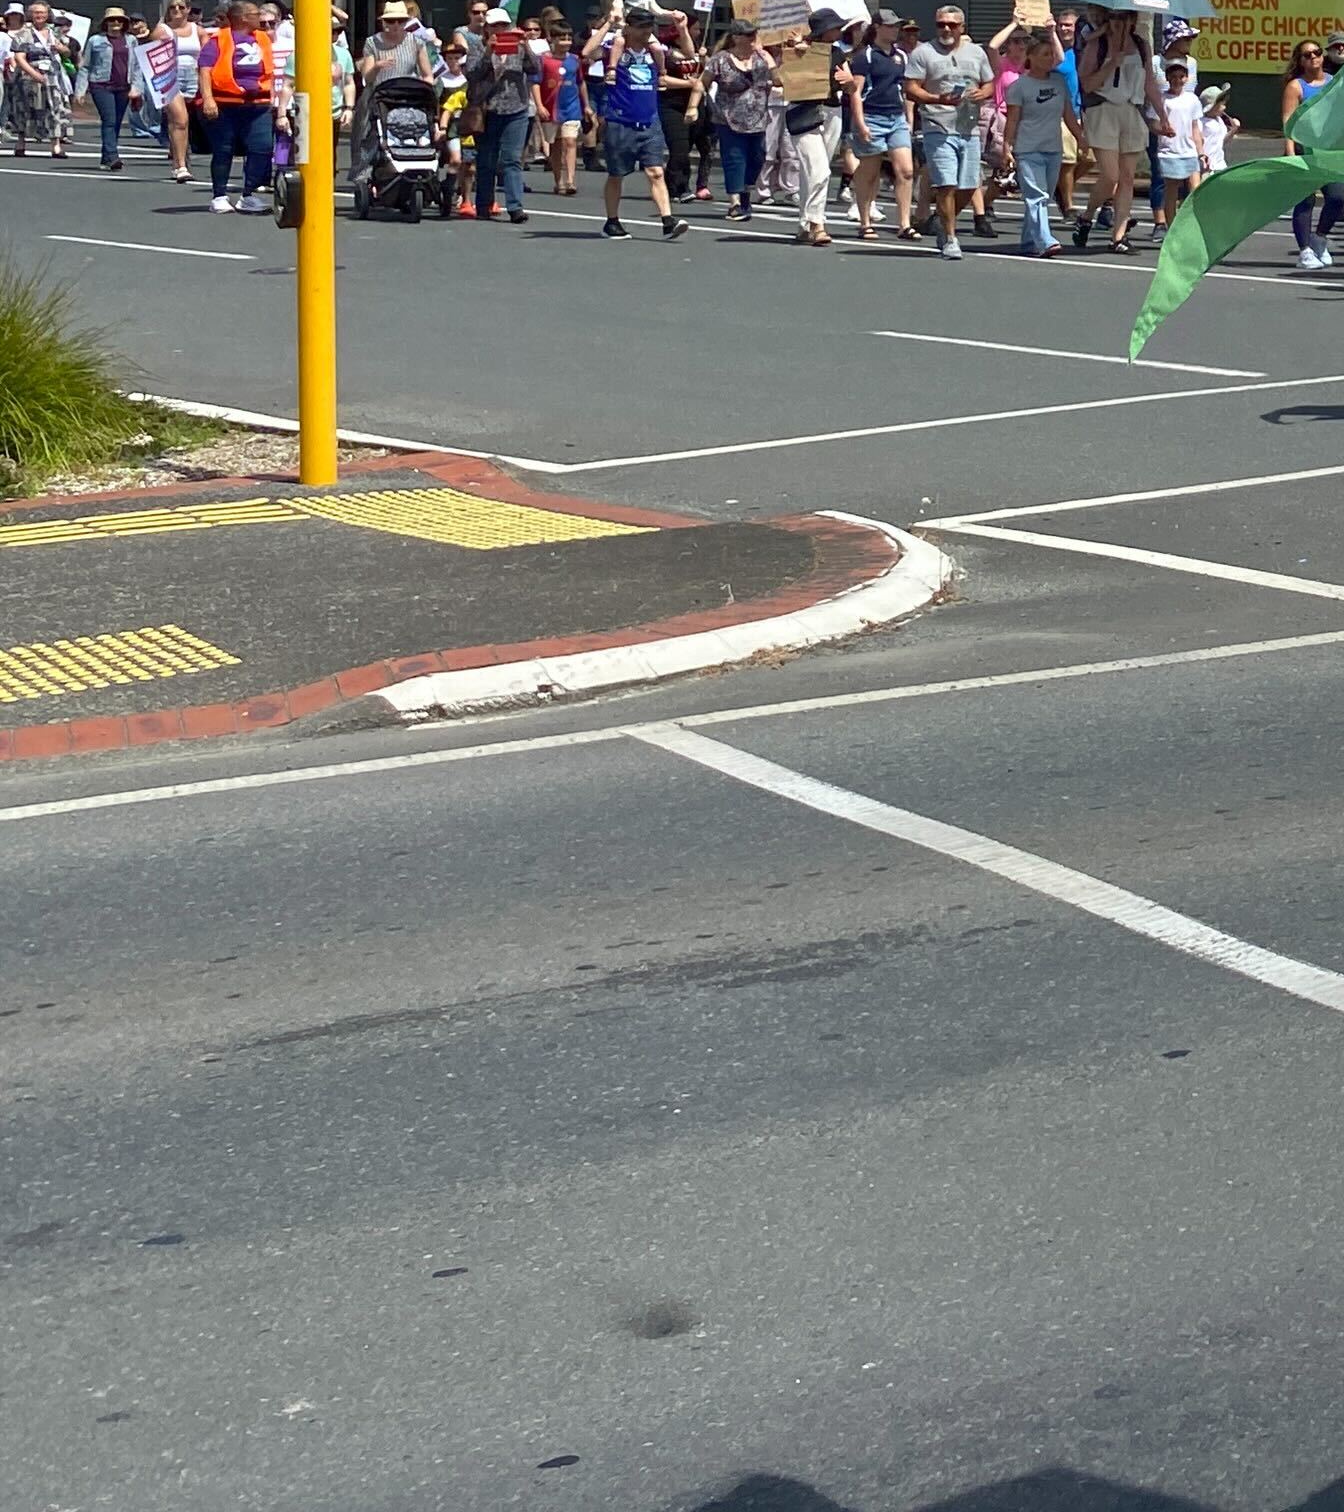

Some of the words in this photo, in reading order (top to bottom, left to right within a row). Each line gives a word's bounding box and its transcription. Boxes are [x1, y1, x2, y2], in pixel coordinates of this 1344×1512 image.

[1197, 16, 1255, 36] FRIED
[1197, 38, 1212, 60] &
[1216, 40, 1292, 61] COFFEE
